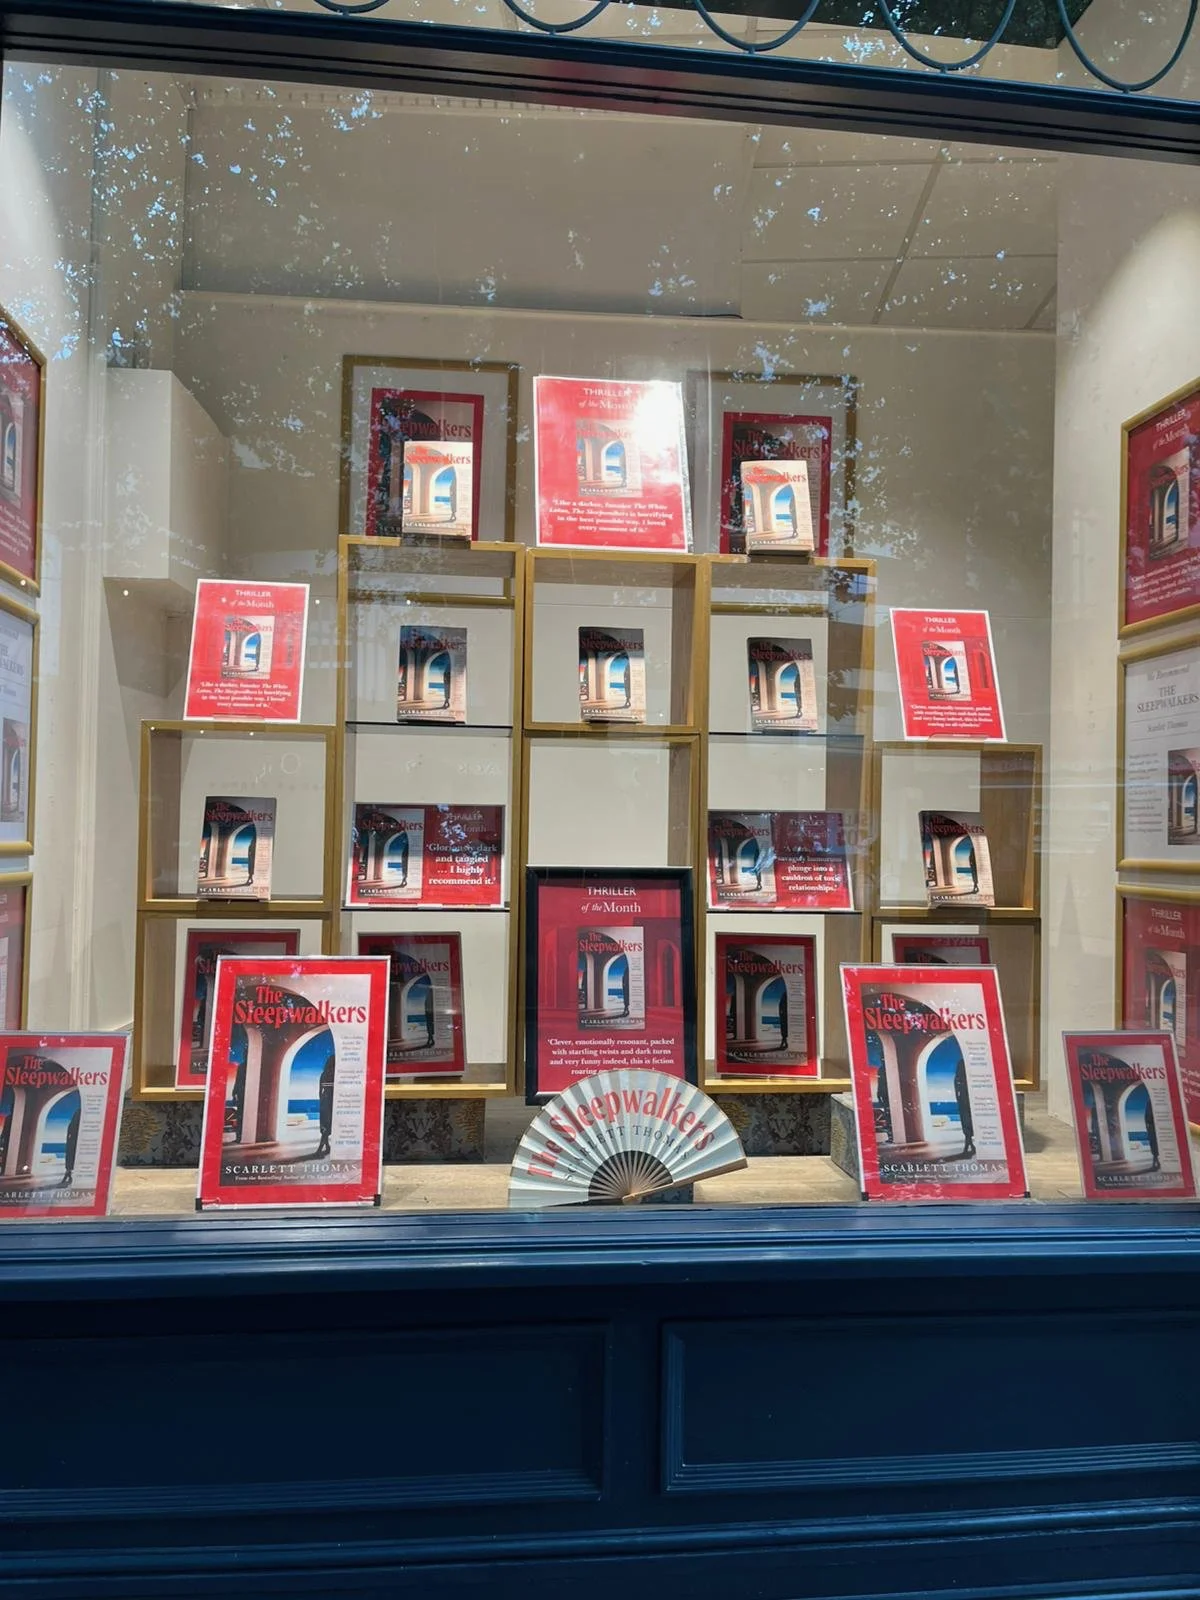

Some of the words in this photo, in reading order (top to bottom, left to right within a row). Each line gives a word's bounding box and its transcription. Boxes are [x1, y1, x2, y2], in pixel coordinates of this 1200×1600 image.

[583, 388, 632, 398] THRILLER
[1156, 409, 1186, 432] THRILLER
[1158, 684, 1176, 698] THE
[1136, 694, 1200, 713] SLEEPWALKERS
[436, 855, 452, 863] and
[456, 855, 488, 865] tangled
[456, 866, 484, 876] highly
[587, 886, 636, 896] THRILLER
[581, 902, 590, 913] of
[592, 903, 602, 912] the
[602, 901, 642, 913] Month
[1151, 908, 1182, 921] THRILLER
[1160, 925, 1186, 940] Month
[579, 939, 643, 954] Sleepwalkers
[728, 960, 804, 974] Sleepwalkers
[256, 985, 283, 1004] The
[880, 994, 907, 1010] The
[234, 1000, 366, 1029] Sleepwalkers
[864, 1008, 986, 1034] Sleepwalkers
[575, 1038, 614, 1047] emotionally
[650, 1038, 674, 1046] packed
[568, 1048, 598, 1056] startling
[23, 1056, 45, 1071] The
[581, 1058, 600, 1066] funny
[1092, 1054, 1110, 1066] The
[6, 1066, 108, 1088] Sleepwalkers
[1082, 1062, 1166, 1082] Sleepwalkers
[527, 1139, 564, 1178] The
[550, 1088, 716, 1151] Sleepwalkers
[225, 1164, 296, 1174] SCARLETT
[303, 1164, 358, 1173] THOMAS
[884, 1164, 948, 1172] SCARLETT
[954, 1163, 1004, 1172] THOMAS
